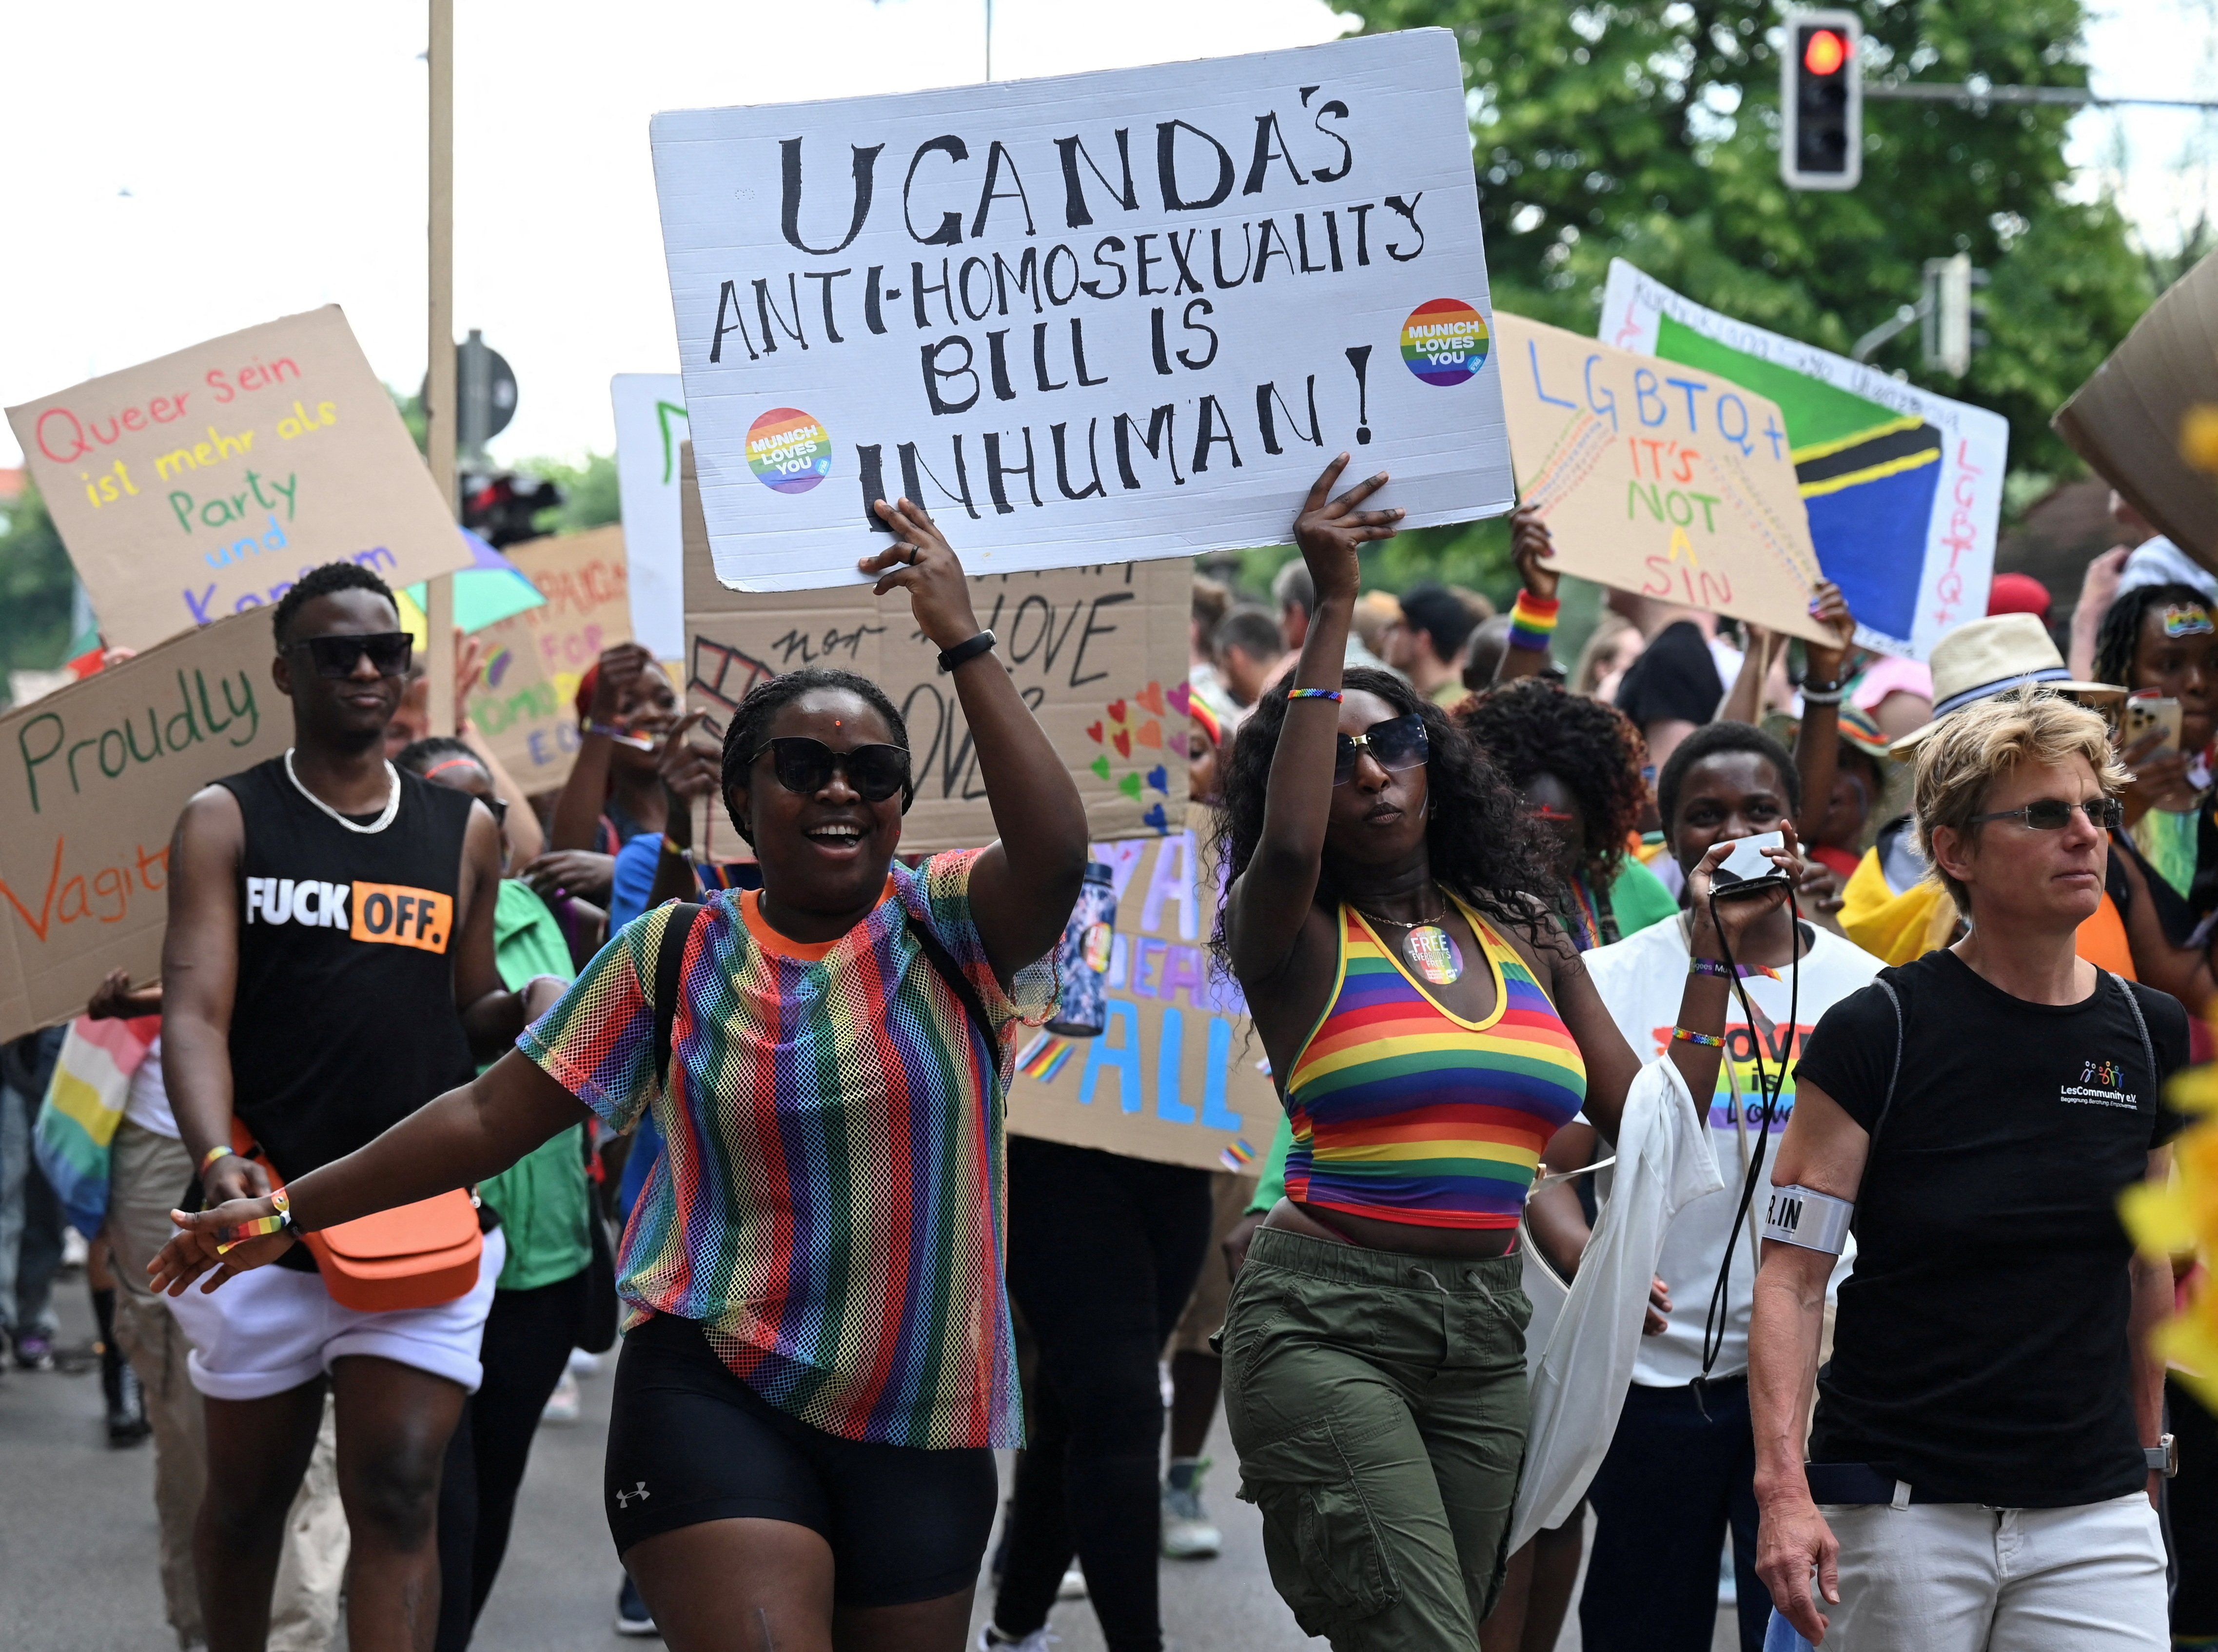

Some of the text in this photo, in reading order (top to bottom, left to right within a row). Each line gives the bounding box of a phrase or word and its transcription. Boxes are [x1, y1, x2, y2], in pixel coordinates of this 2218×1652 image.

[779, 85, 1352, 255] UGANDA'S
[710, 192, 1424, 363] ANTI-HOMOSEXUALITY
[1409, 320, 1479, 338] MUNICH
[1415, 335, 1475, 353] LOVES
[920, 298, 1218, 415] BILL IS
[1427, 351, 1465, 366] YOU
[1528, 339, 1784, 461] LGBTQ+
[36, 389, 191, 464] Queer
[751, 425, 818, 453] MUNICH
[80, 400, 338, 509] ist mehr als
[761, 440, 817, 465] LOVES
[775, 456, 812, 475] YOU
[1629, 436, 1702, 484] IT'S
[168, 468, 298, 534] Party
[1628, 480, 1722, 533] NOT
[204, 515, 288, 570] und
[1669, 526, 1698, 566] A
[1642, 555, 1733, 606] SIN
[19, 667, 260, 814] Proudly
[247, 876, 443, 945] FUCK OFF.
[1410, 934, 1449, 953] FREE
[1426, 959, 1445, 968] FREE
[1078, 999, 1243, 1132] ALL
[1751, 1067, 1780, 1092] is
[2061, 1085, 2137, 1103] LesCommunity e.V.
